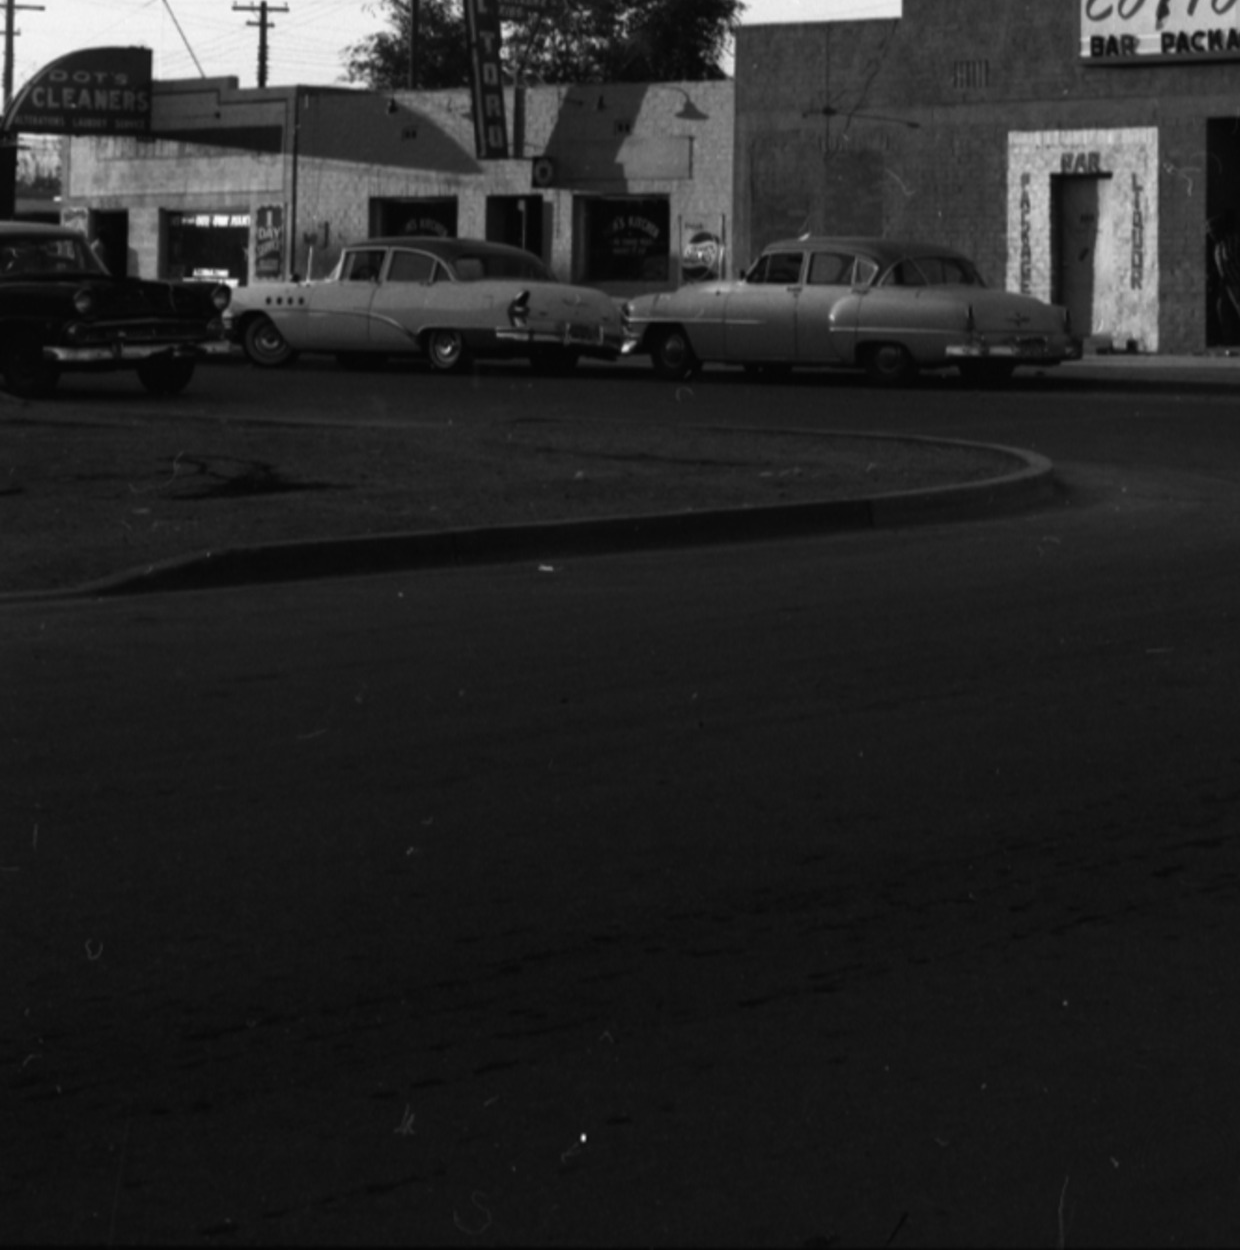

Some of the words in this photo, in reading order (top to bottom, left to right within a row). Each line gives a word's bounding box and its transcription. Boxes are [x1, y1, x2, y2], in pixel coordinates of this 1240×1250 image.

[1089, 35, 1136, 57] BAR
[49, 71, 128, 86] DOT'S
[31, 87, 149, 112] CLEANERS
[1061, 150, 1100, 173] BAR
[258, 227, 281, 240] DAY
[1131, 172, 1144, 290] LIQUOR
